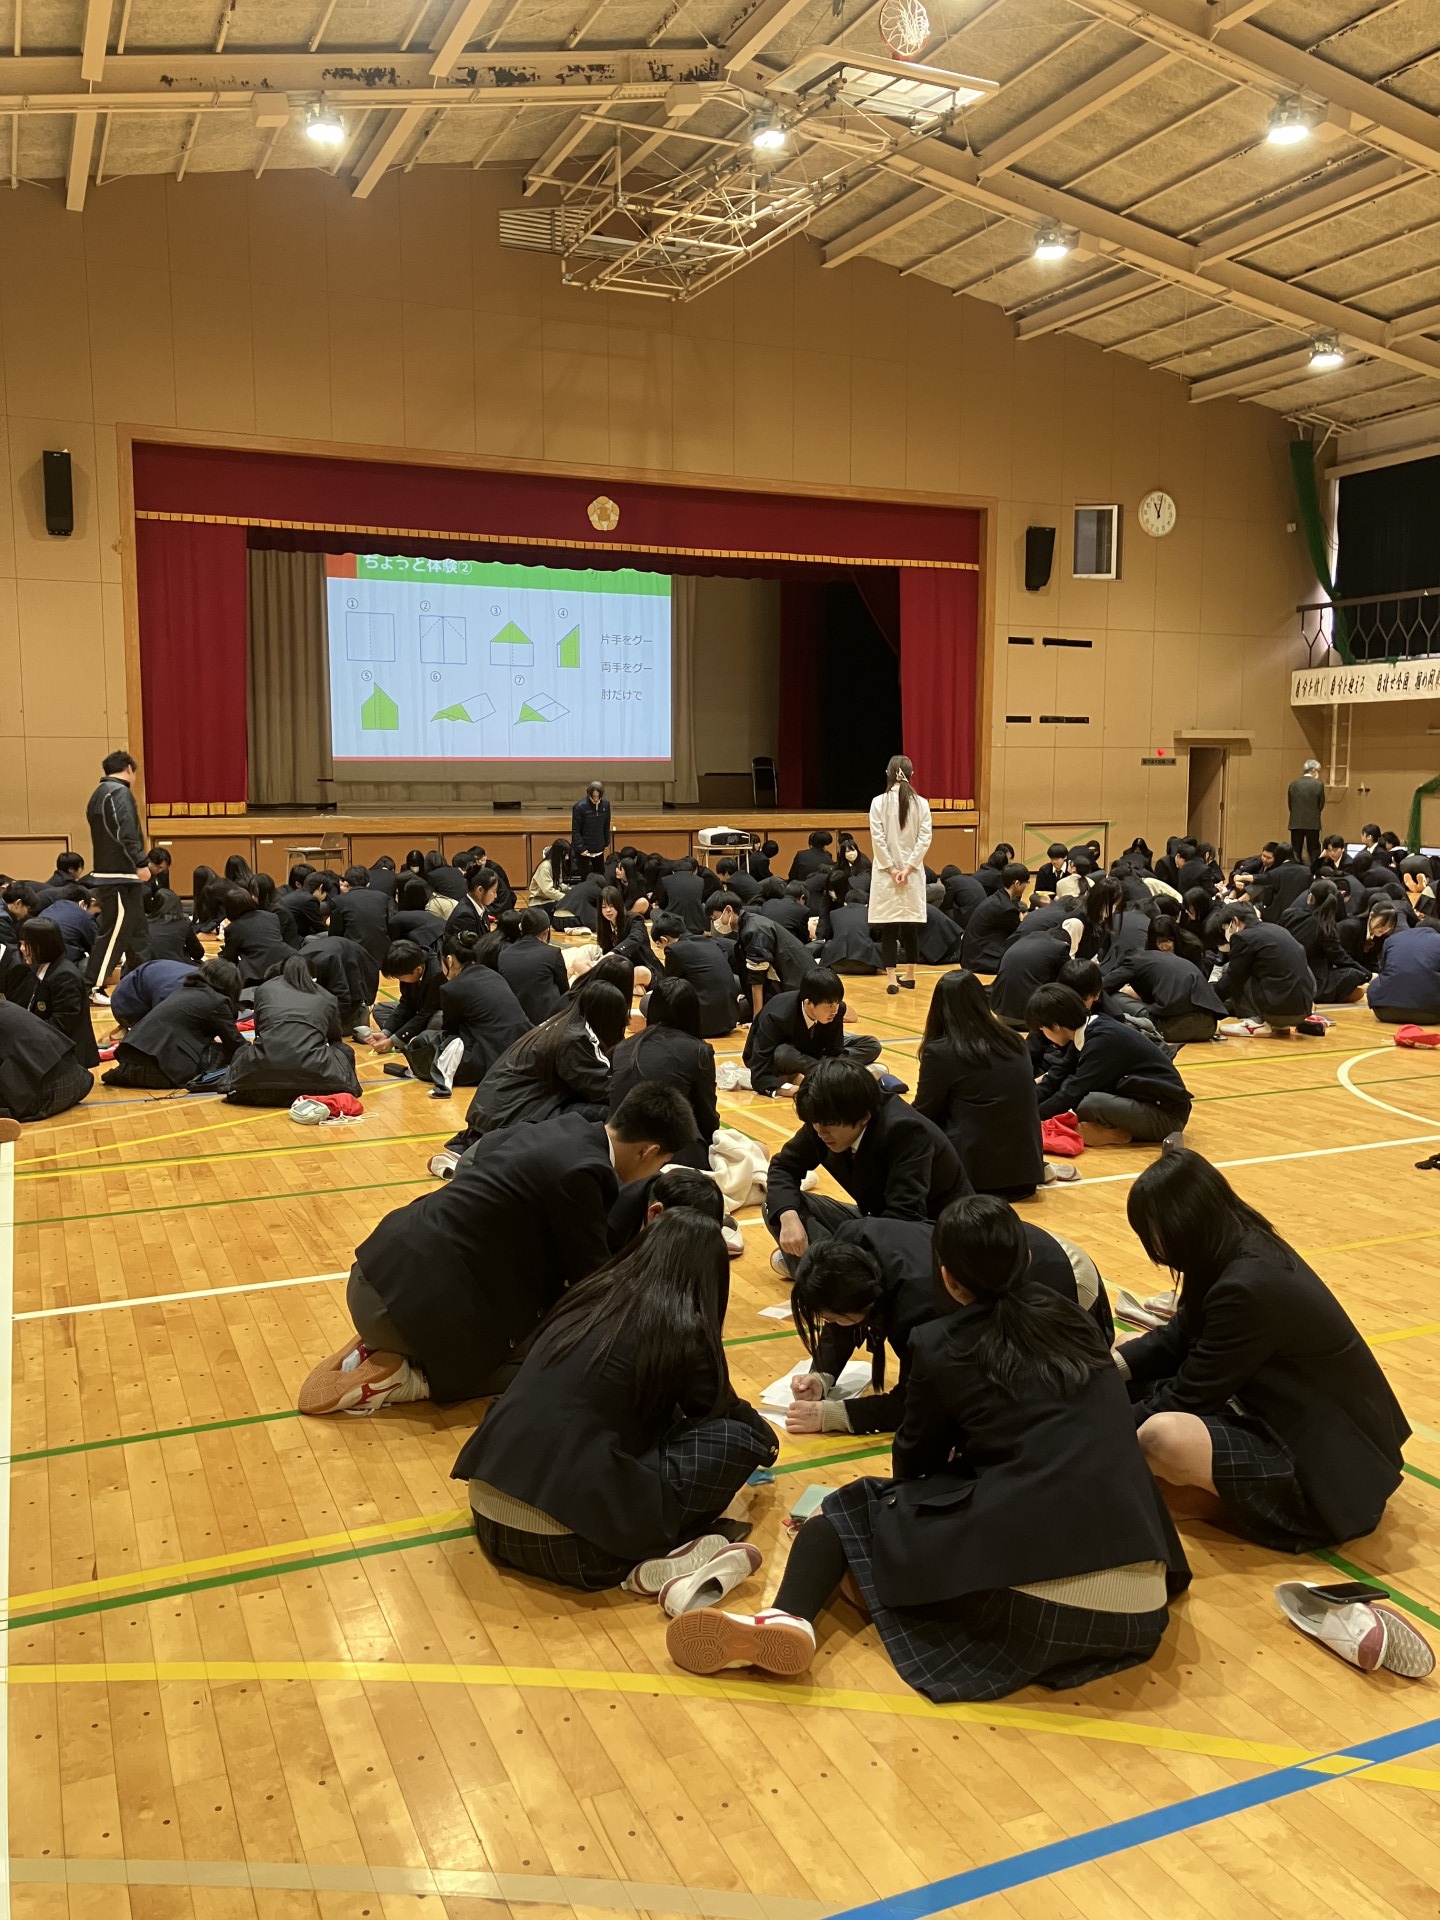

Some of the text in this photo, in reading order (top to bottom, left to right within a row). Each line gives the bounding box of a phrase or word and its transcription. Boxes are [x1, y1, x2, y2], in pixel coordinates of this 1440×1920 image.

[600, 634, 653, 646] 片手をグー
[601, 662, 653, 673] 両手をグー
[601, 689, 643, 701] 肘だけで
